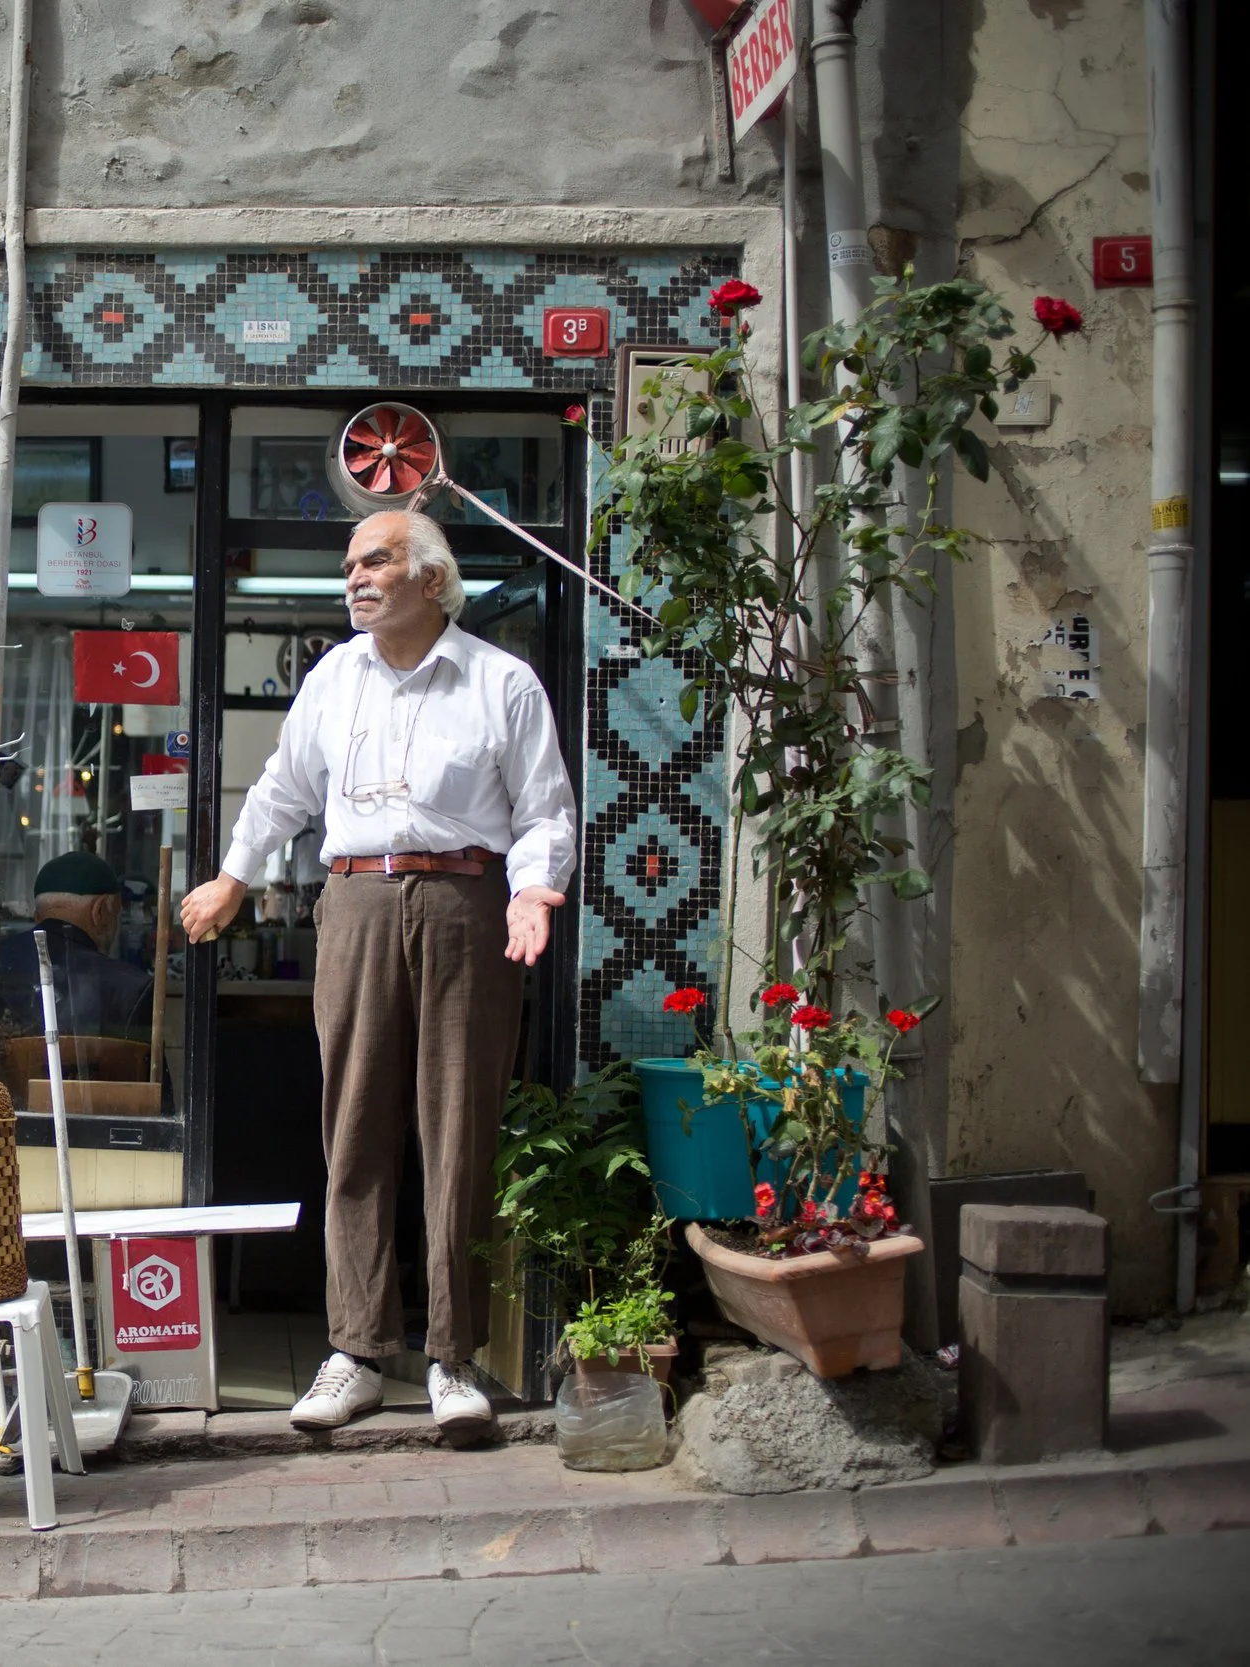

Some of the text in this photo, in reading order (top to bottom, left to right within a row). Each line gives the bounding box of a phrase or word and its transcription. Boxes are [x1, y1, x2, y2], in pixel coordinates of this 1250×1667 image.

[731, 0, 794, 120] BERBER
[1121, 247, 1136, 272] 5
[96, 560, 121, 568] ODASI
